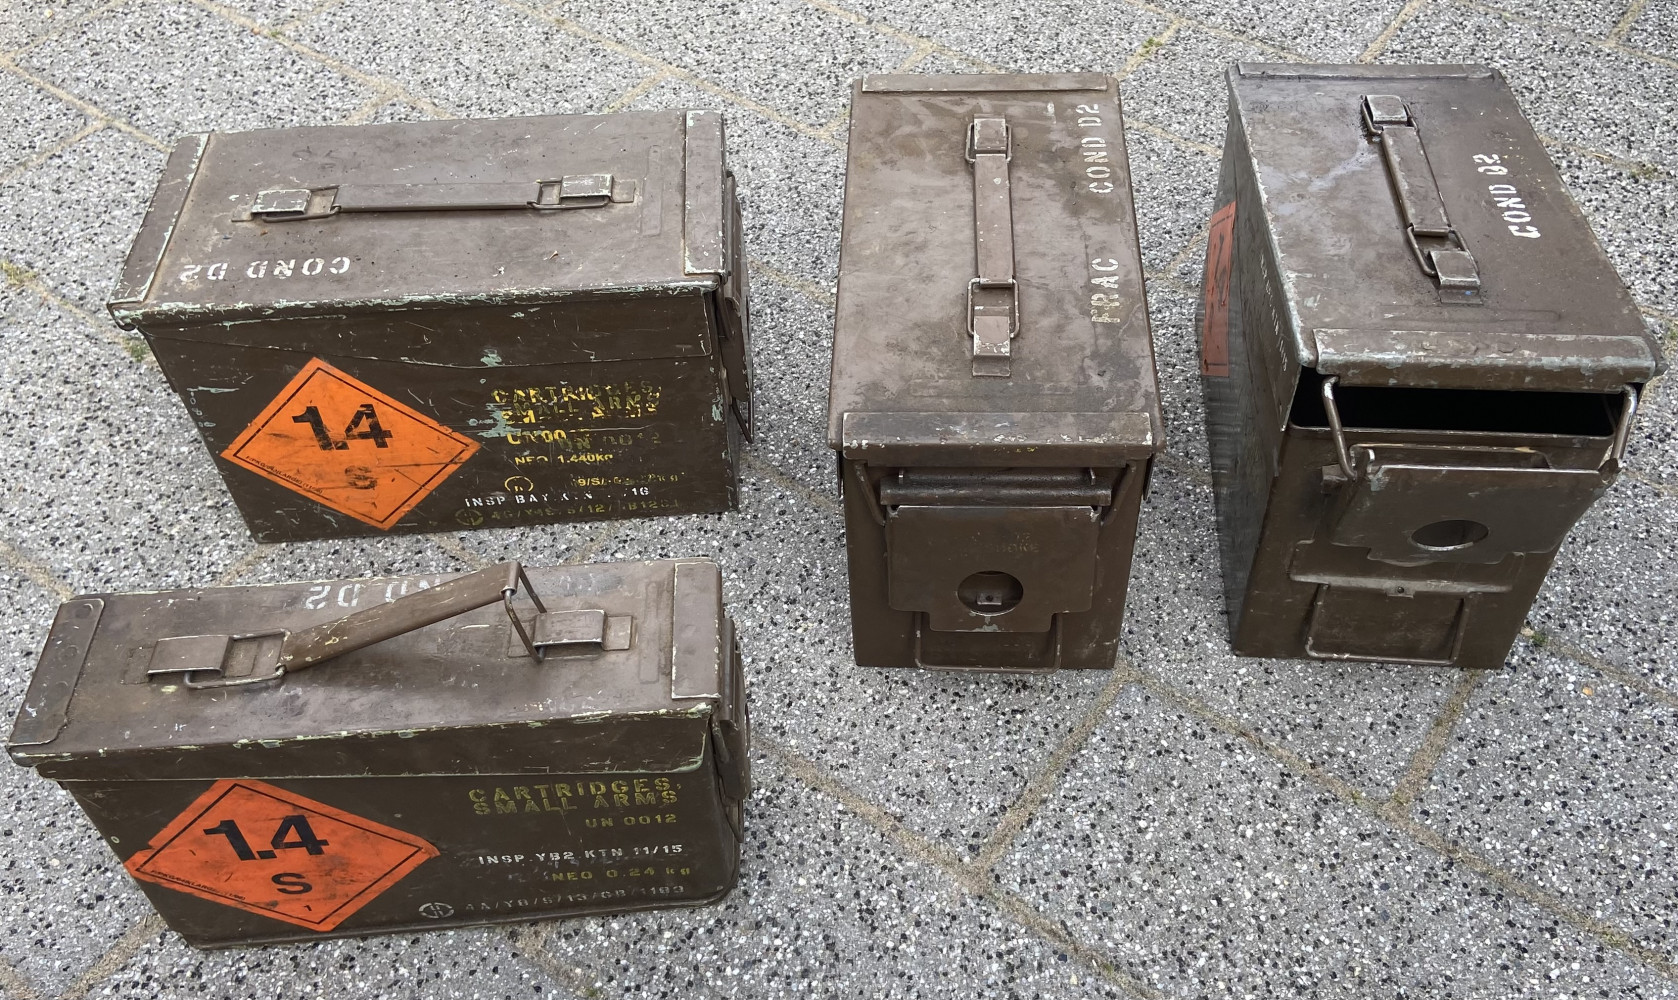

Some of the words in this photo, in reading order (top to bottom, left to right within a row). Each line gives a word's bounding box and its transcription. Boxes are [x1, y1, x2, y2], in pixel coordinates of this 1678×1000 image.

[1075, 102, 1102, 128] D2
[1081, 136, 1114, 194] COND
[1487, 184, 1542, 239] COND
[179, 262, 229, 282] D2
[246, 256, 351, 281] COND
[291, 403, 393, 451] 1.4
[344, 464, 378, 490] S
[464, 494, 506, 508] INSP
[305, 583, 361, 611] D2
[473, 798, 579, 816] SMALL
[593, 790, 679, 810] ARMS
[585, 817, 615, 829] UN
[622, 812, 678, 827] 0012
[202, 814, 330, 862] 1.4
[478, 853, 526, 866] INSP
[270, 871, 314, 895] S
[551, 871, 594, 882] NEO
